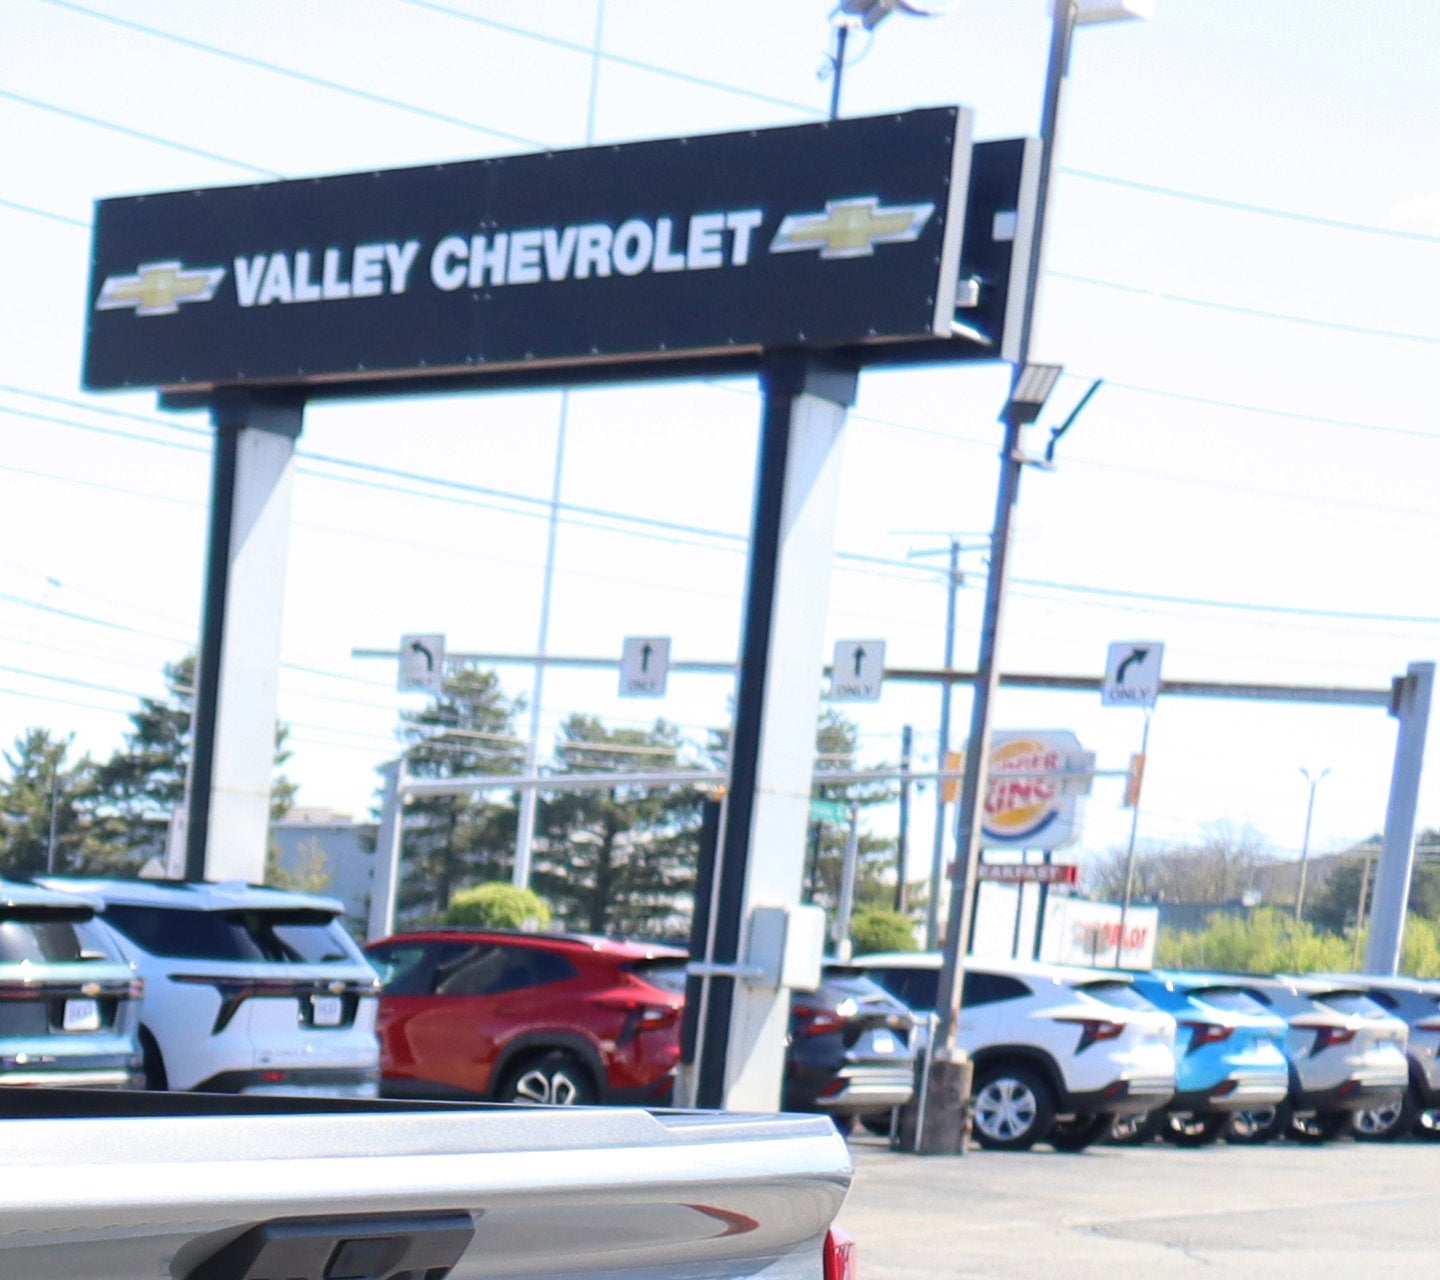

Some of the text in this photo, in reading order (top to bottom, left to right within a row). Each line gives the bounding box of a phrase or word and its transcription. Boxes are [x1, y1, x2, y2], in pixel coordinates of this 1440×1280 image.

[233, 210, 762, 306] VALLEY CHEVROLET
[979, 864, 1059, 880] EAKFAST
